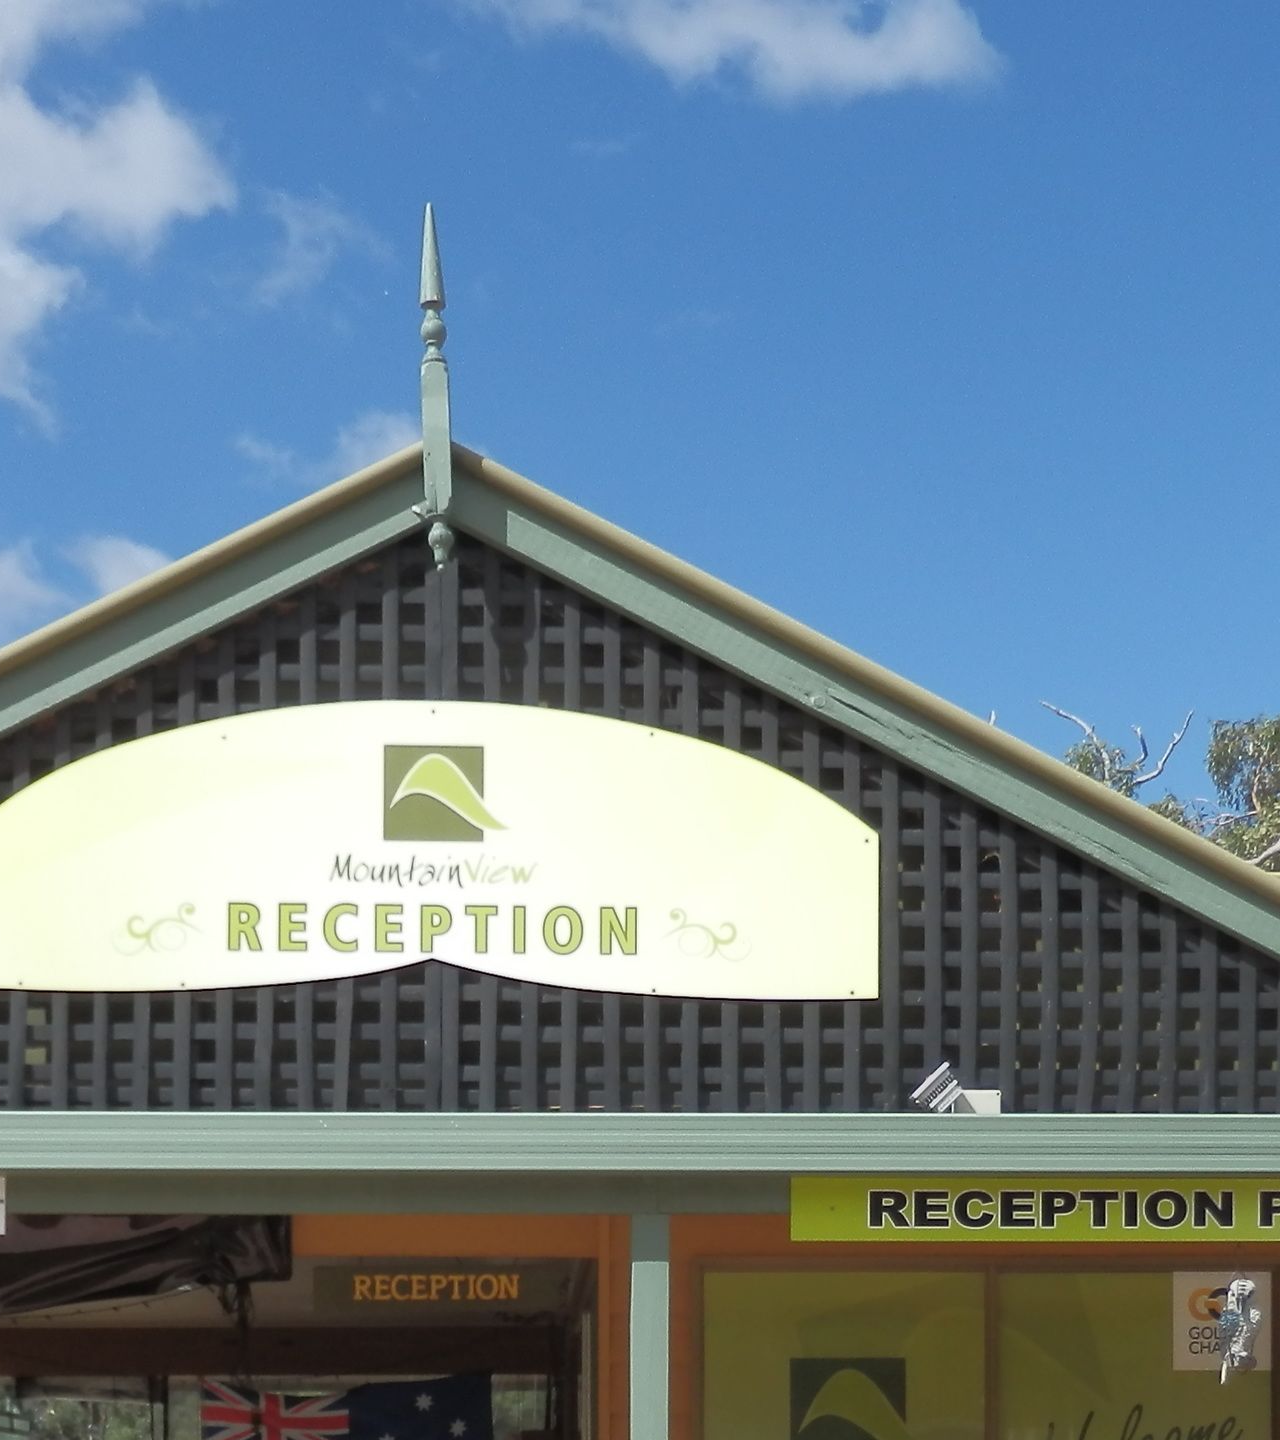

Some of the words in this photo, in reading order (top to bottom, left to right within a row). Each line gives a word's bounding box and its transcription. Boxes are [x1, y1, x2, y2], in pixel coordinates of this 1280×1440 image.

[228, 902, 638, 955] RECEPTION
[867, 1189, 1233, 1228] RECEPTION
[353, 1273, 519, 1300] RECEPTION
[1188, 1326, 1221, 1340] GOL
[1188, 1341, 1221, 1355] CHA
